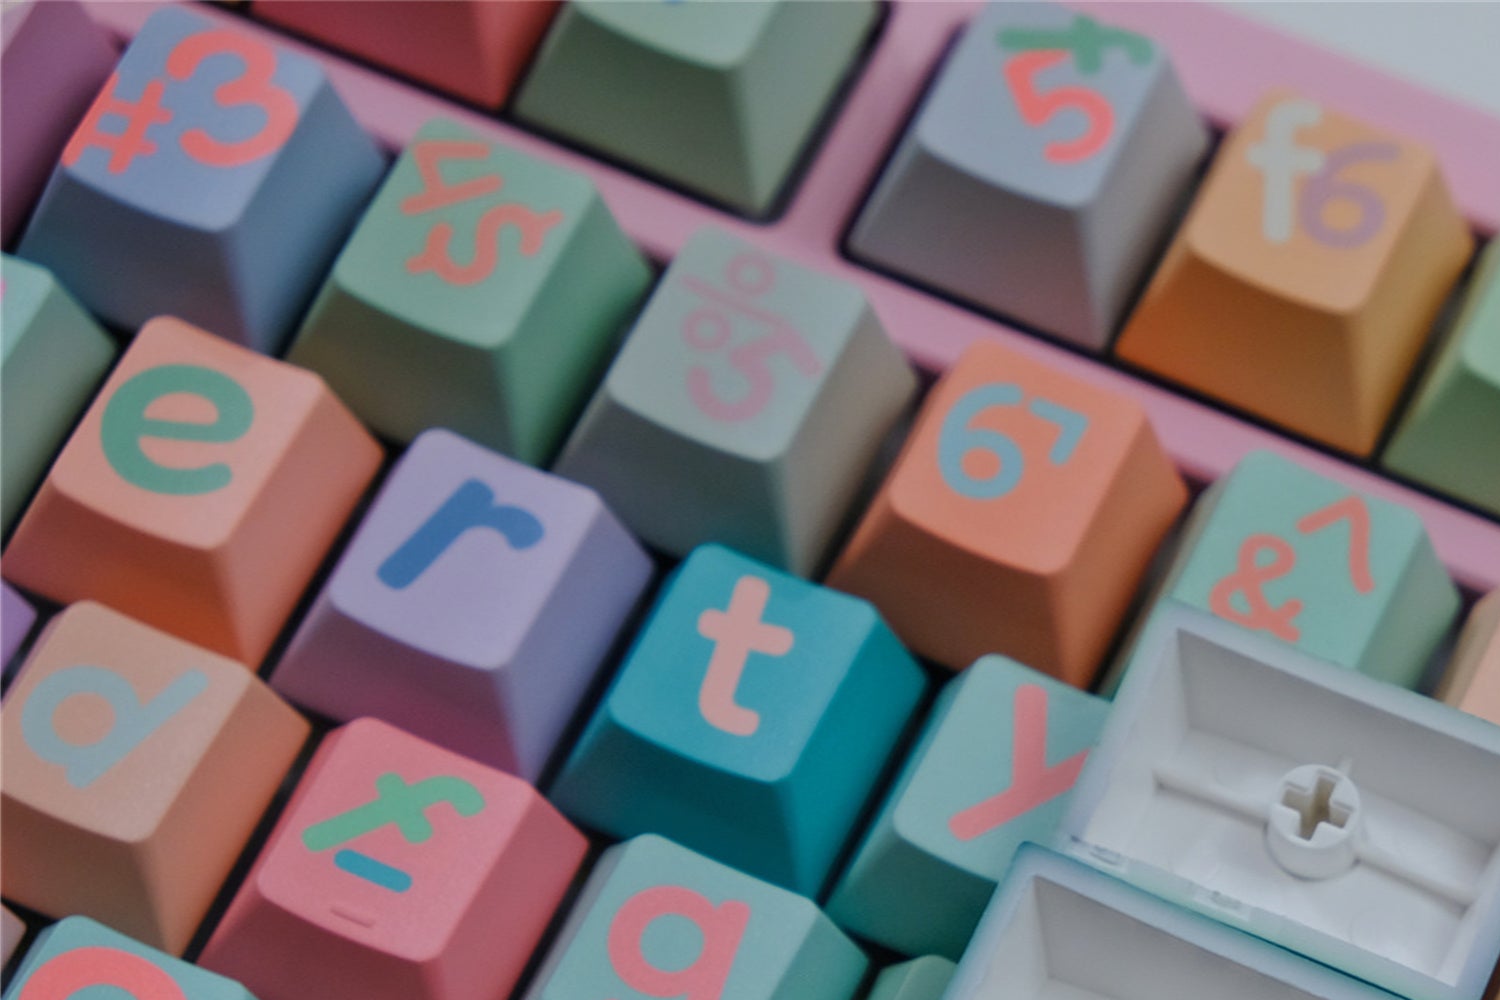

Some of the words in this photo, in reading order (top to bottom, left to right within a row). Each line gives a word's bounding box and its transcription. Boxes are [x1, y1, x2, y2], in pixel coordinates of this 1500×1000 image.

[100, 364, 254, 495] e
[376, 478, 545, 590] r
[698, 576, 794, 736] t
[20, 665, 209, 789] d
[949, 684, 1090, 840] y
